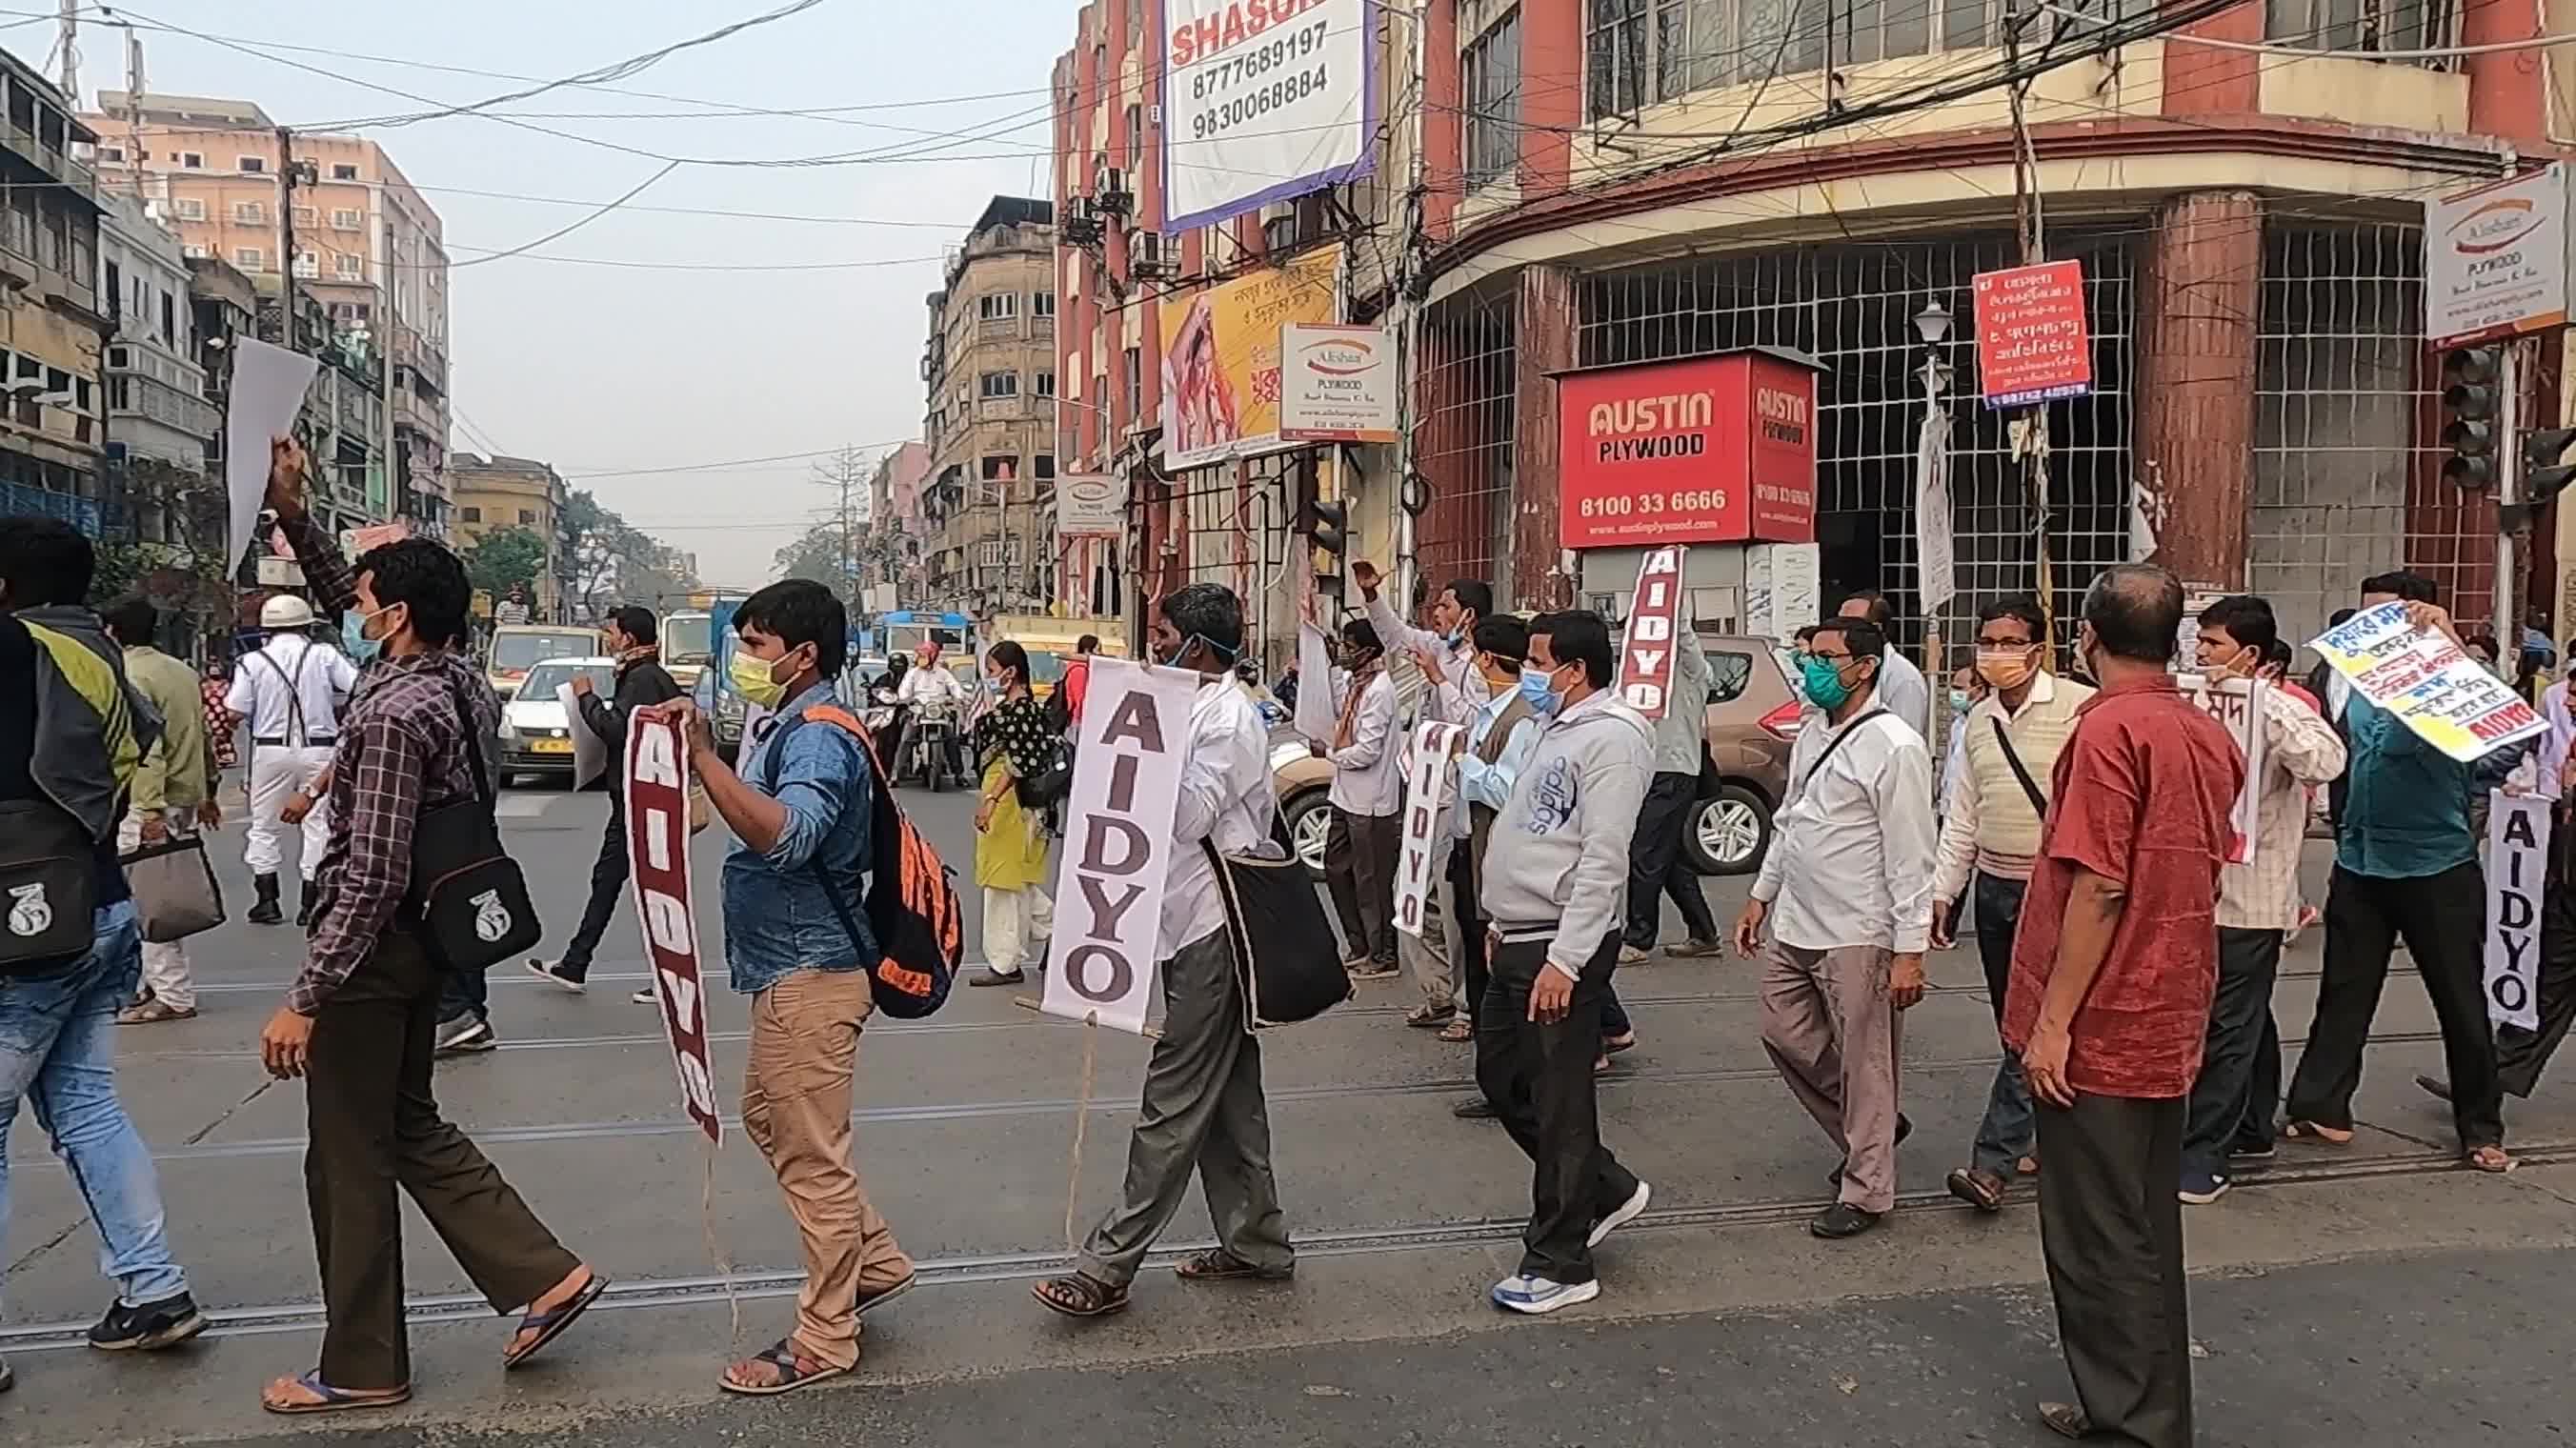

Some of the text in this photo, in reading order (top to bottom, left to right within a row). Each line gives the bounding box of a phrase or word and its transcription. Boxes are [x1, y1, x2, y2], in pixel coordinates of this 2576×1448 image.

[1193, 20, 1327, 100] 8777689197
[1193, 64, 1327, 139] 9830068884
[1589, 391, 1713, 436] AUSTIN
[1600, 433, 1704, 463] PLYWOOD
[1581, 490, 1726, 517] 8100 33 6666
[1626, 550, 1677, 710] AIDYO
[2468, 701, 2536, 741] AIDYO
[1401, 723, 1446, 928] AIDYO
[1528, 755, 1567, 835] adidas
[1064, 690, 1166, 1003] AIDYO
[636, 723, 714, 1116] AIDYO
[2491, 809, 2536, 1012] AIDYO
